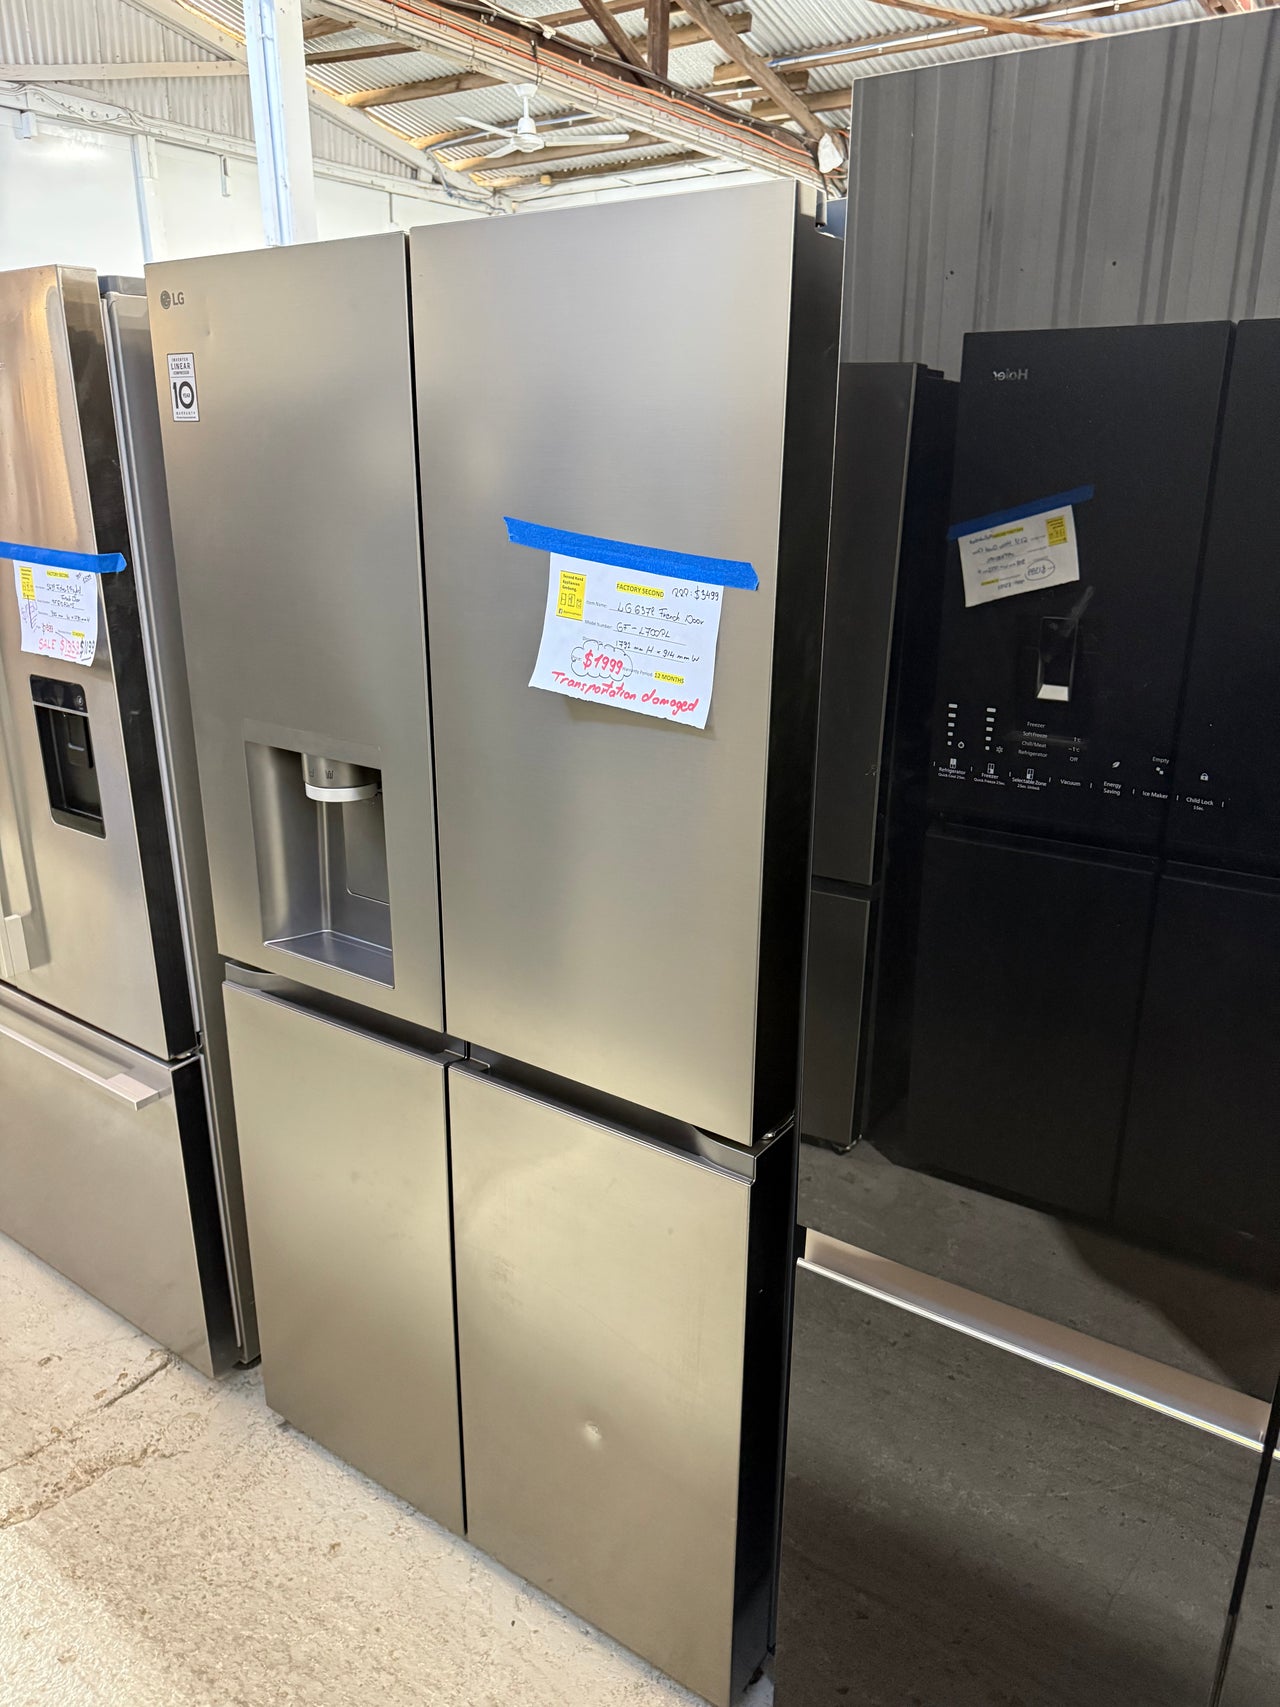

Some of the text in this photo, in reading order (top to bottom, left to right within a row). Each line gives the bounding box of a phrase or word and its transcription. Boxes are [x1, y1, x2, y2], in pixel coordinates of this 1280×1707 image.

[172, 292, 185, 306] LG
[170, 362, 191, 370] LINEAR
[173, 381, 195, 409] 10
[616, 583, 664, 598] FACTORY SECOND
[694, 585, 719, 601] $3499
[617, 602, 632, 614] LG
[659, 607, 680, 622] French
[582, 649, 623, 675] $1999
[661, 674, 685, 684] MONTHS
[551, 671, 700, 716] Transportation damaged
[1017, 749, 1048, 758] Refrigerator
[1152, 756, 1170, 765] Empty
[938, 766, 966, 775] Refrigerator
[1011, 776, 1035, 785] Selectable
[1060, 779, 1081, 787] Vacuum
[1103, 781, 1122, 789] Energy
[1103, 788, 1121, 796] Saving
[1150, 791, 1169, 800] Maker
